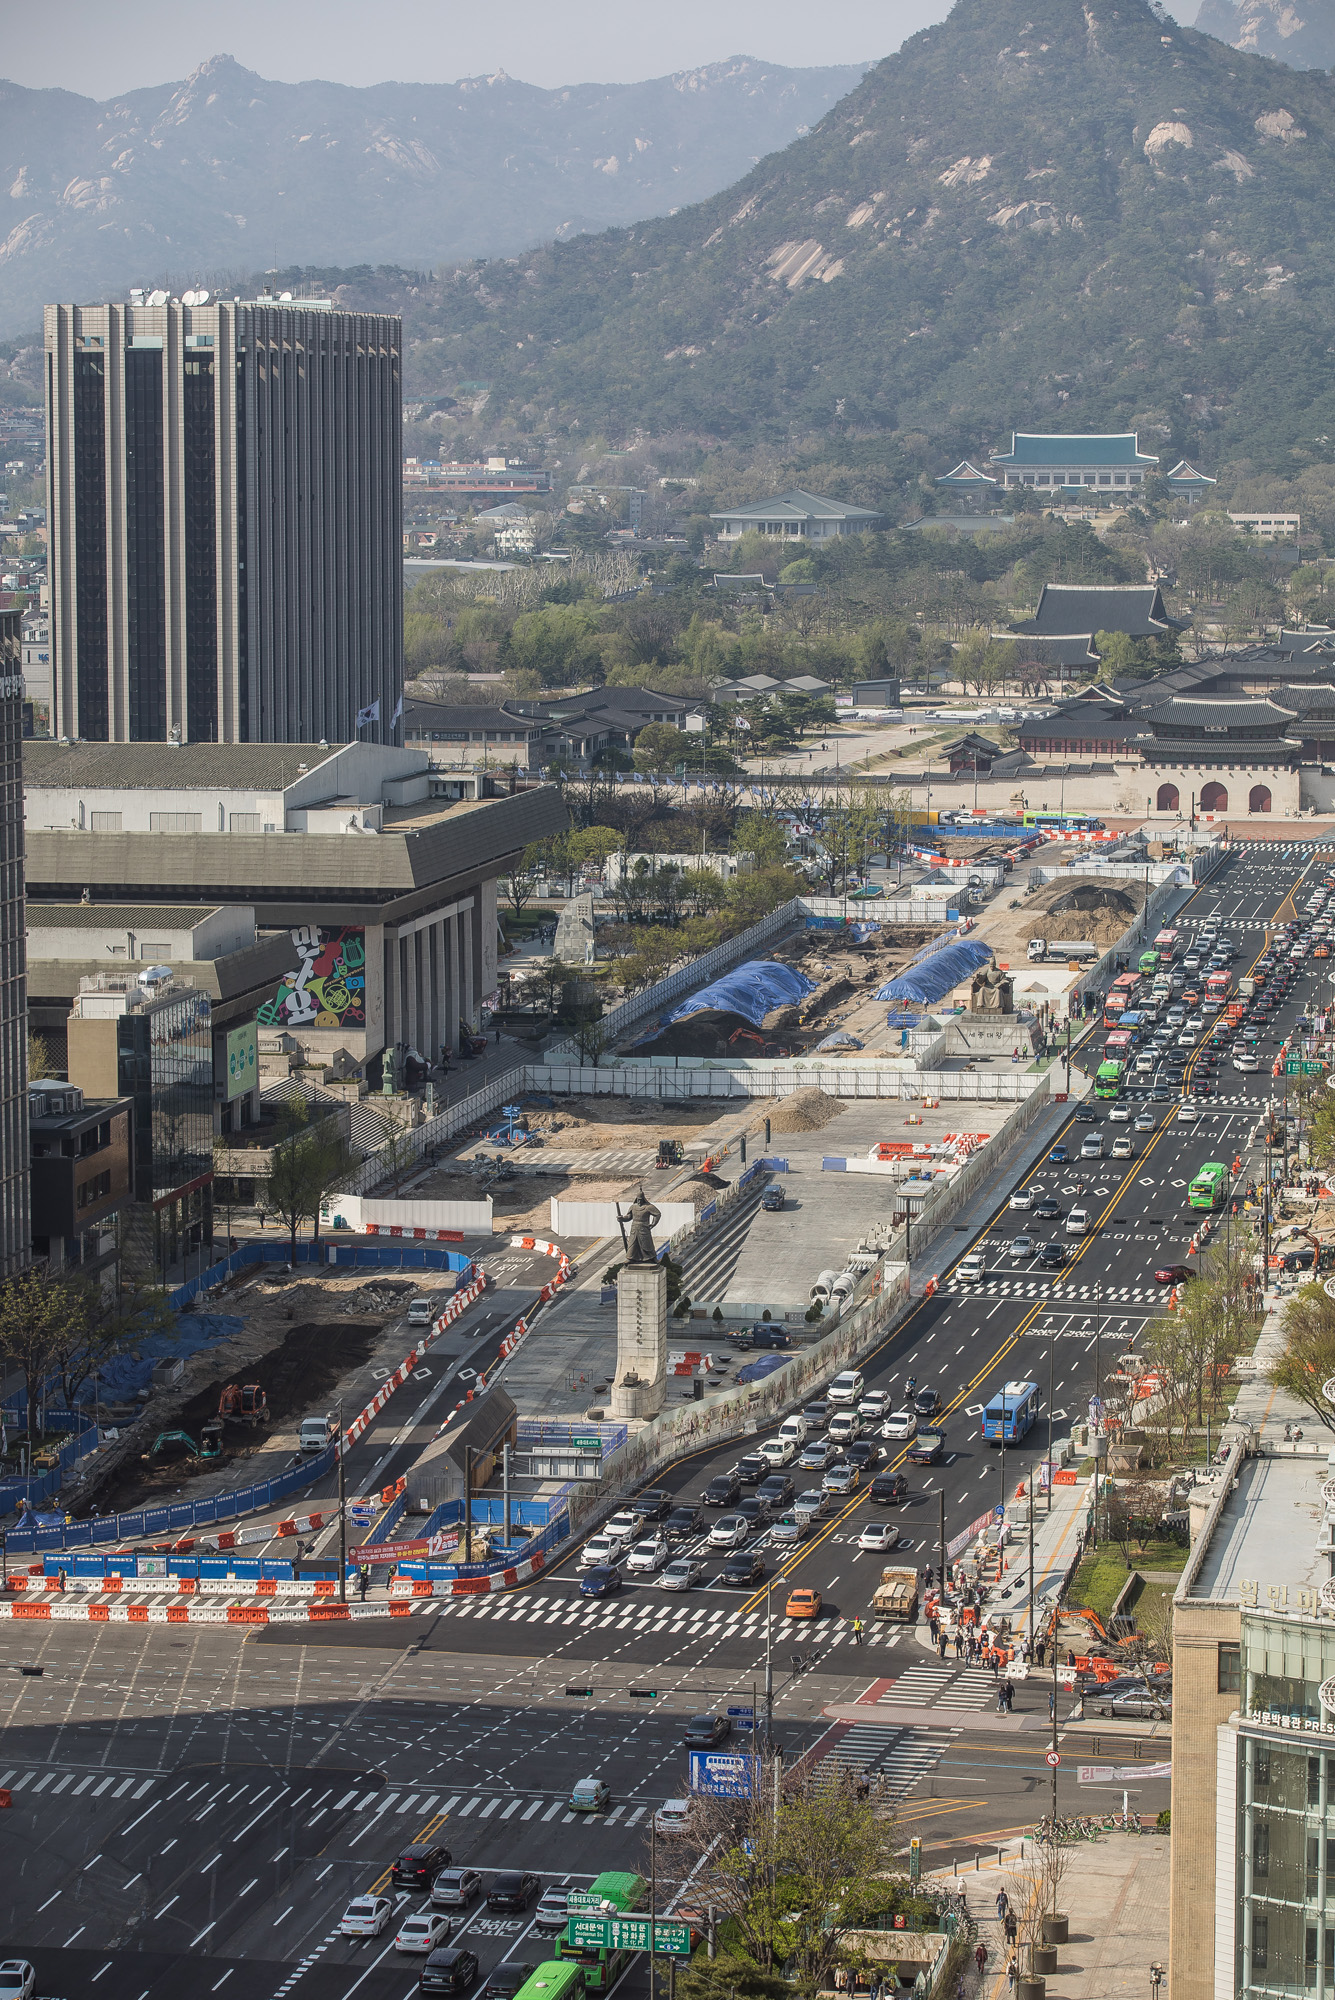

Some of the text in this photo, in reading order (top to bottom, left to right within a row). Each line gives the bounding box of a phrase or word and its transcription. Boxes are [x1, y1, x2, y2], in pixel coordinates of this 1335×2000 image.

[968, 1031, 1003, 1039] 세종대왕
[1101, 1232, 1126, 1240] 50
[426, 1535, 443, 1557] 12
[1252, 1709, 1335, 1734] 신문박물관 PRES
[569, 1895, 600, 1905] 세종대로사거리
[574, 1922, 604, 1932] 서대문역
[621, 1923, 646, 1932] 독립문
[621, 1931, 646, 1941] 광화문
